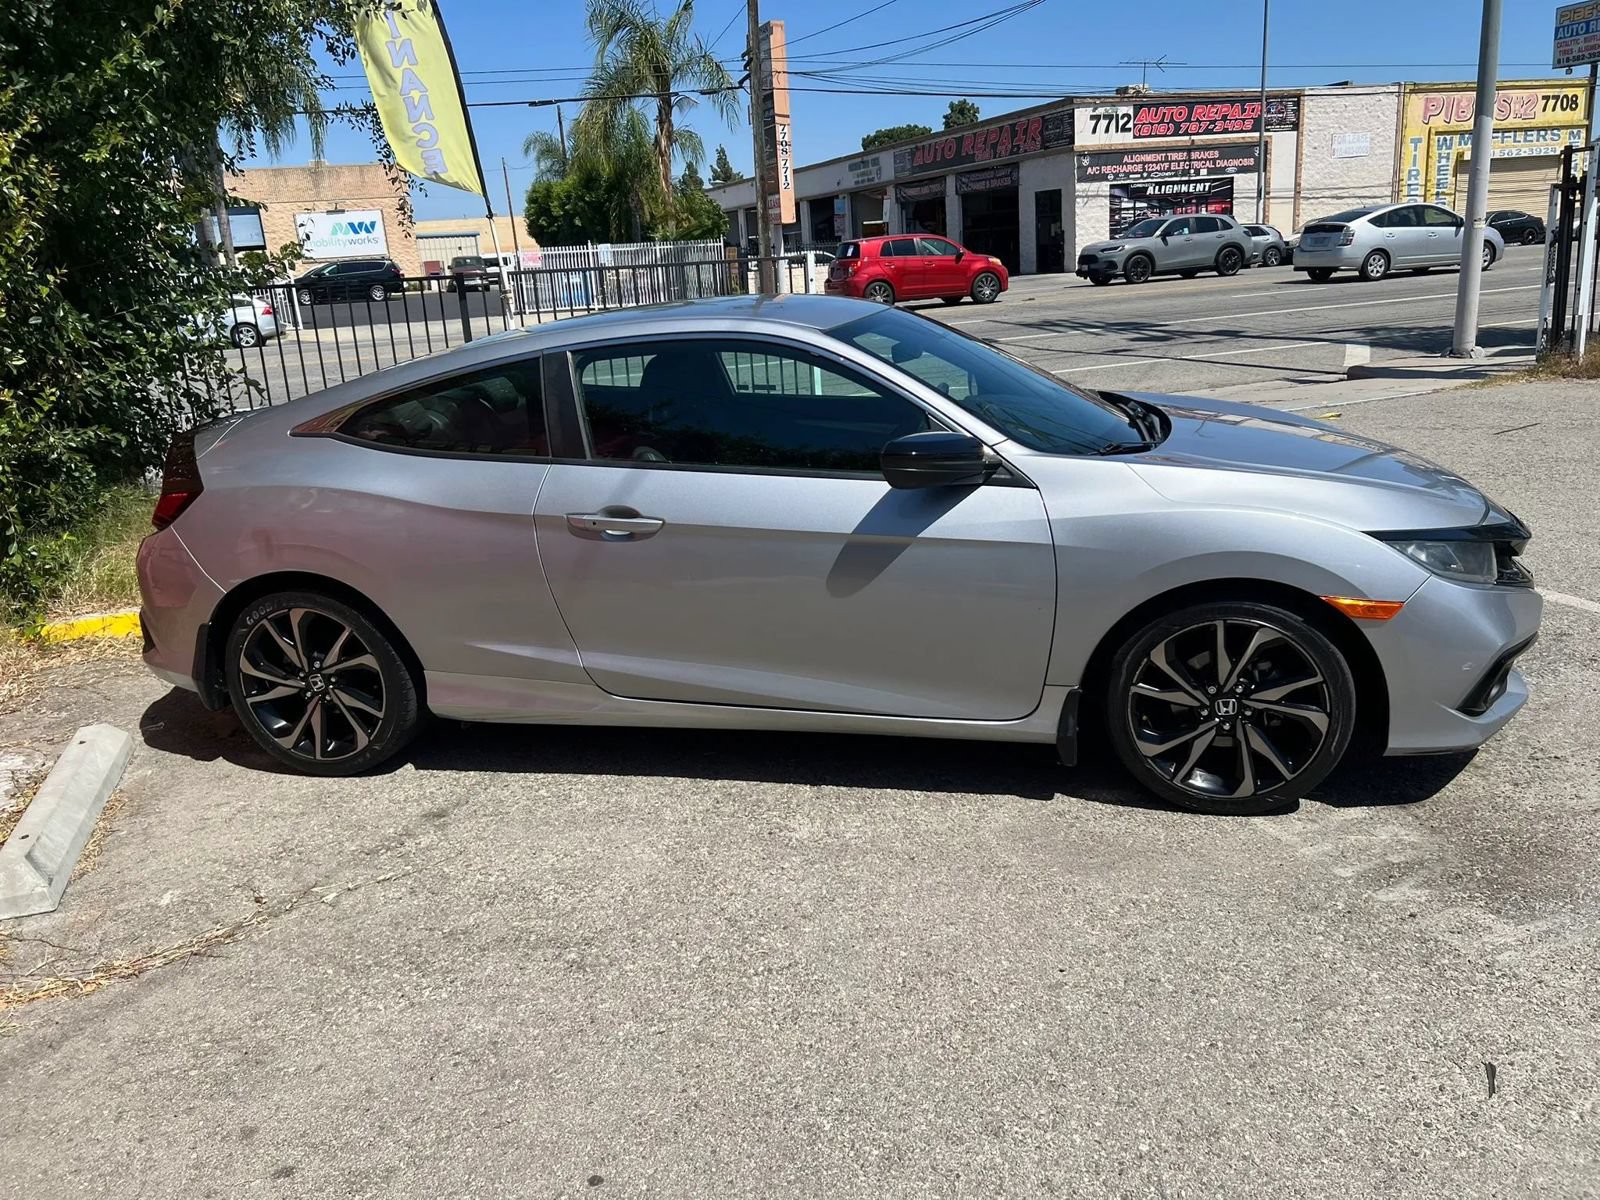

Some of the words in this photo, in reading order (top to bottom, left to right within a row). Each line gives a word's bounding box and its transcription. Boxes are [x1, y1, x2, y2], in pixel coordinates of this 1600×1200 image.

[1557, 23, 1586, 39] AUTO
[1422, 94, 1512, 124] PIB'S
[1541, 94, 1579, 113] 7708
[1089, 112, 1132, 135] 7712
[1134, 106, 1188, 124] AUTO
[779, 124, 789, 155] 7708
[913, 138, 956, 167] AUTO
[961, 117, 1042, 157] REPAIR
[1458, 127, 1561, 147] MFLERS
[1086, 166, 1100, 175] A/C
[1101, 163, 1143, 174] RECHARGE
[1144, 162, 1170, 172] 1234YF
[1170, 160, 1215, 170] ELECTRICAL
[1215, 157, 1255, 168] DIAGNOSIS
[1122, 153, 1166, 163] ALIGNMENT
[781, 158, 791, 190] 7712
[1146, 182, 1212, 195] ALIGNMENT
